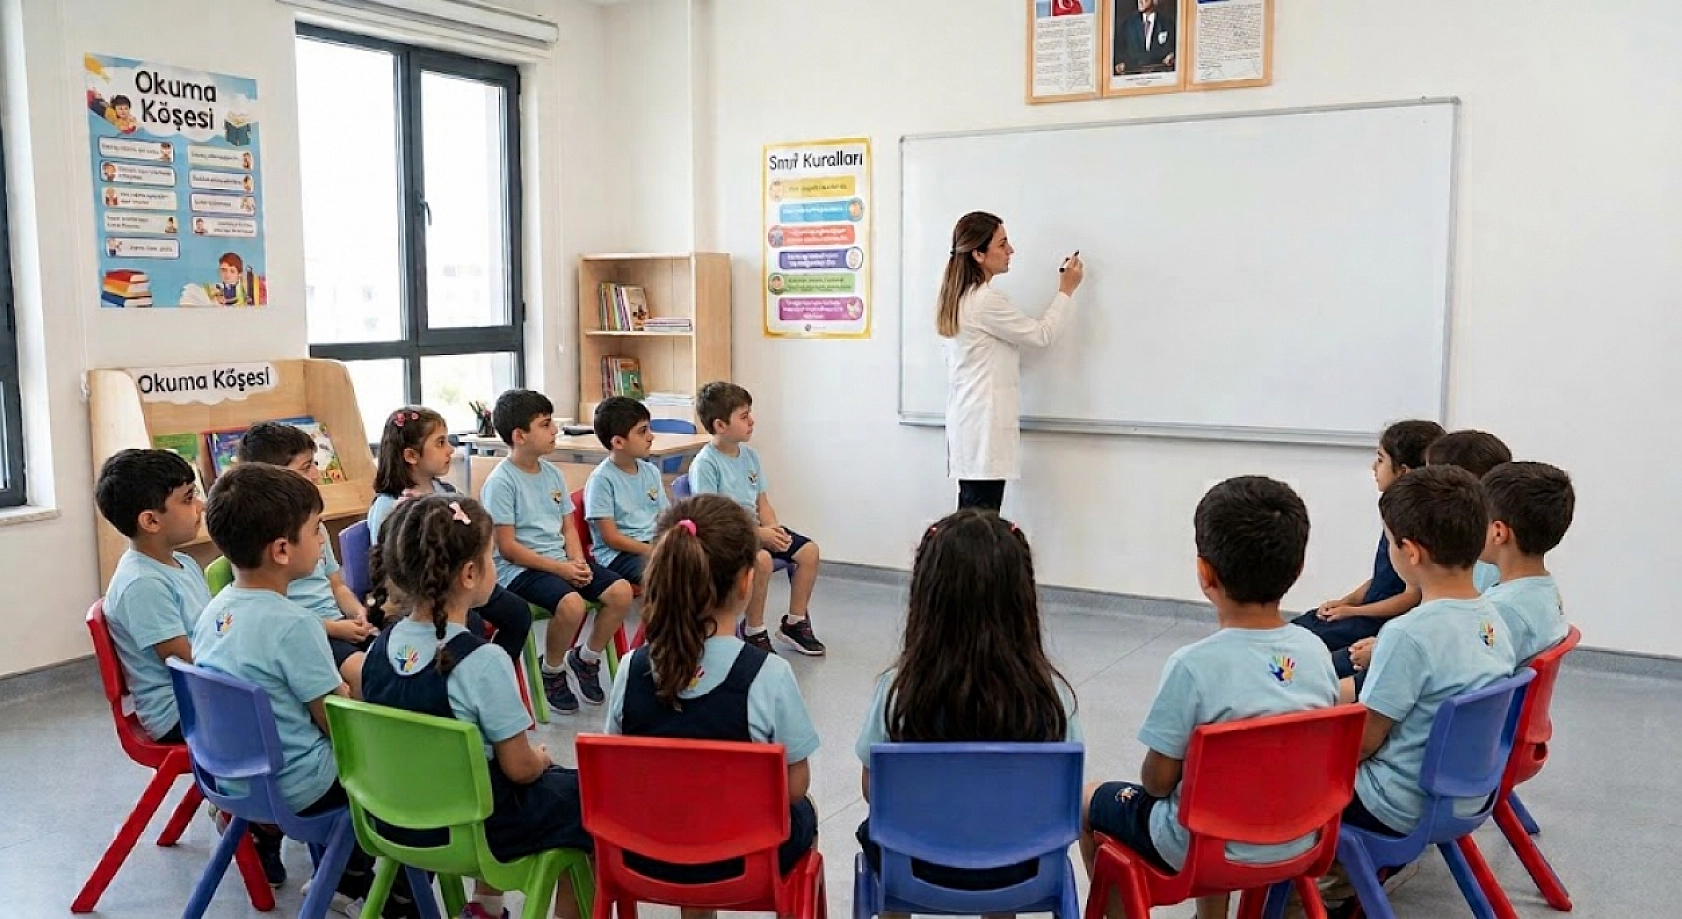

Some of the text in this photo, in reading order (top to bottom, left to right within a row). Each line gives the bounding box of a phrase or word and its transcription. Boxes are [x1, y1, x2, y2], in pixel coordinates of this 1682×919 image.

[135, 70, 217, 102] Okuma
[141, 98, 215, 131] Köşesi
[138, 372, 208, 394] Okuma
